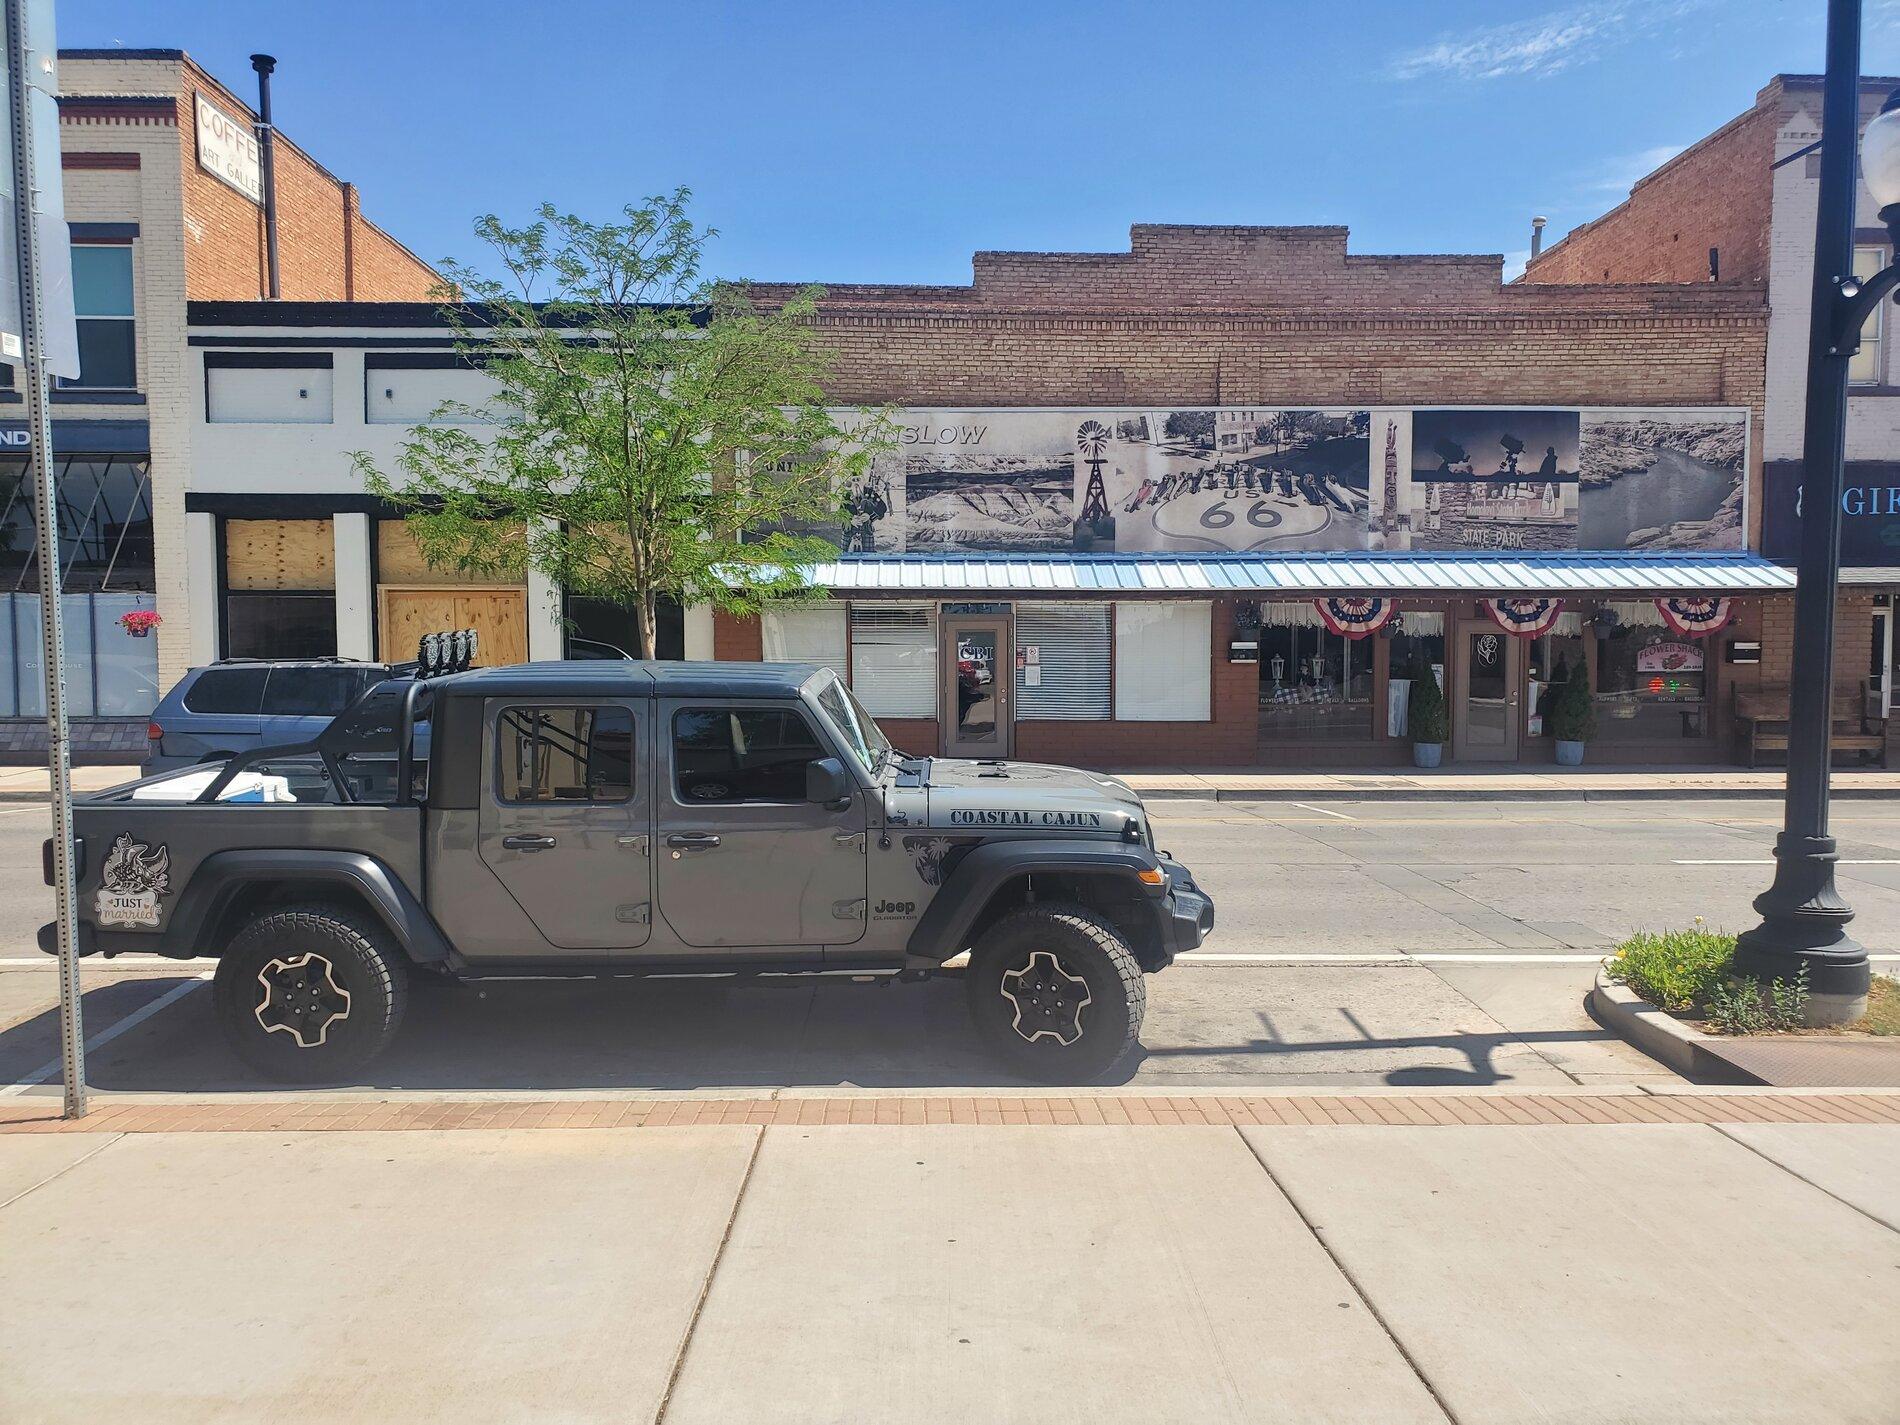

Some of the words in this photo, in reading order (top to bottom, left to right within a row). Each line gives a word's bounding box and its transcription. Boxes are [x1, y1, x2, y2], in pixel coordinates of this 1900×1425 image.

[203, 145, 219, 168] ART
[227, 163, 264, 197] GALLER
[1200, 500, 1282, 529] 66
[1463, 528, 1490, 544] STATE
[1496, 530, 1526, 549] PARK
[960, 646, 994, 661] CBI
[1640, 644, 1675, 660] FLOWER
[1677, 644, 1703, 659] SHACK
[950, 810, 1033, 825] COASTAL
[1042, 811, 1101, 827] CAJUN
[113, 898, 143, 908] JUST
[874, 899, 916, 915] Jeep
[104, 905, 156, 920] married
